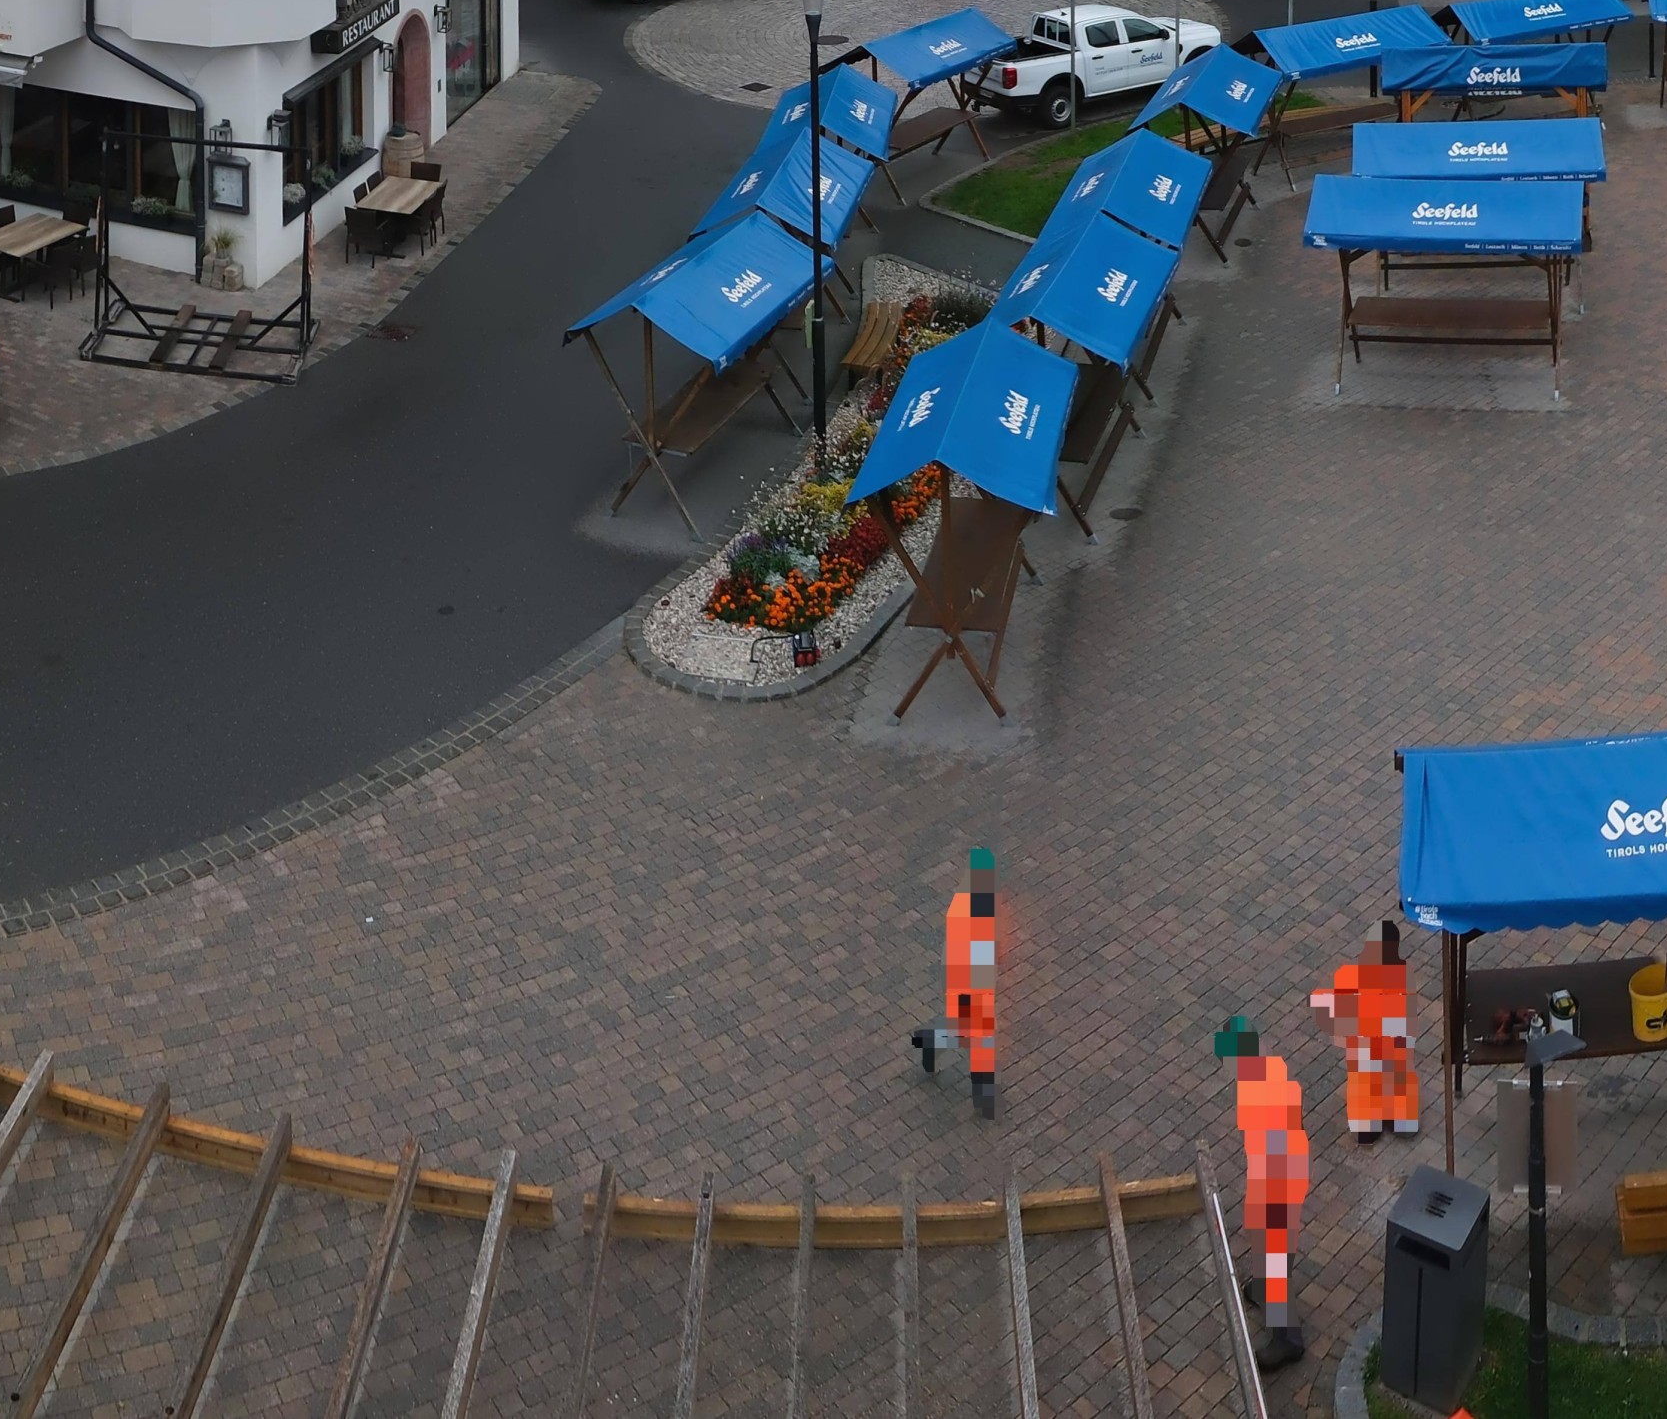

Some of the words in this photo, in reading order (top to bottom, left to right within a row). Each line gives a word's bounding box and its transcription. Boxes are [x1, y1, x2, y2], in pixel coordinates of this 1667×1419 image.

[1524, 3, 1563, 18] Seefeld
[1335, 32, 1377, 50] Seefeld
[1466, 67, 1521, 85] Seefeld
[1448, 141, 1508, 156] Seefeld
[1149, 174, 1172, 202] Seefeld
[1412, 202, 1478, 219] Seefeld
[721, 268, 763, 303] Seefeld
[1097, 268, 1128, 303] Seefeld
[999, 390, 1029, 435] Seefeld
[1605, 845, 1646, 859] TIROLS
